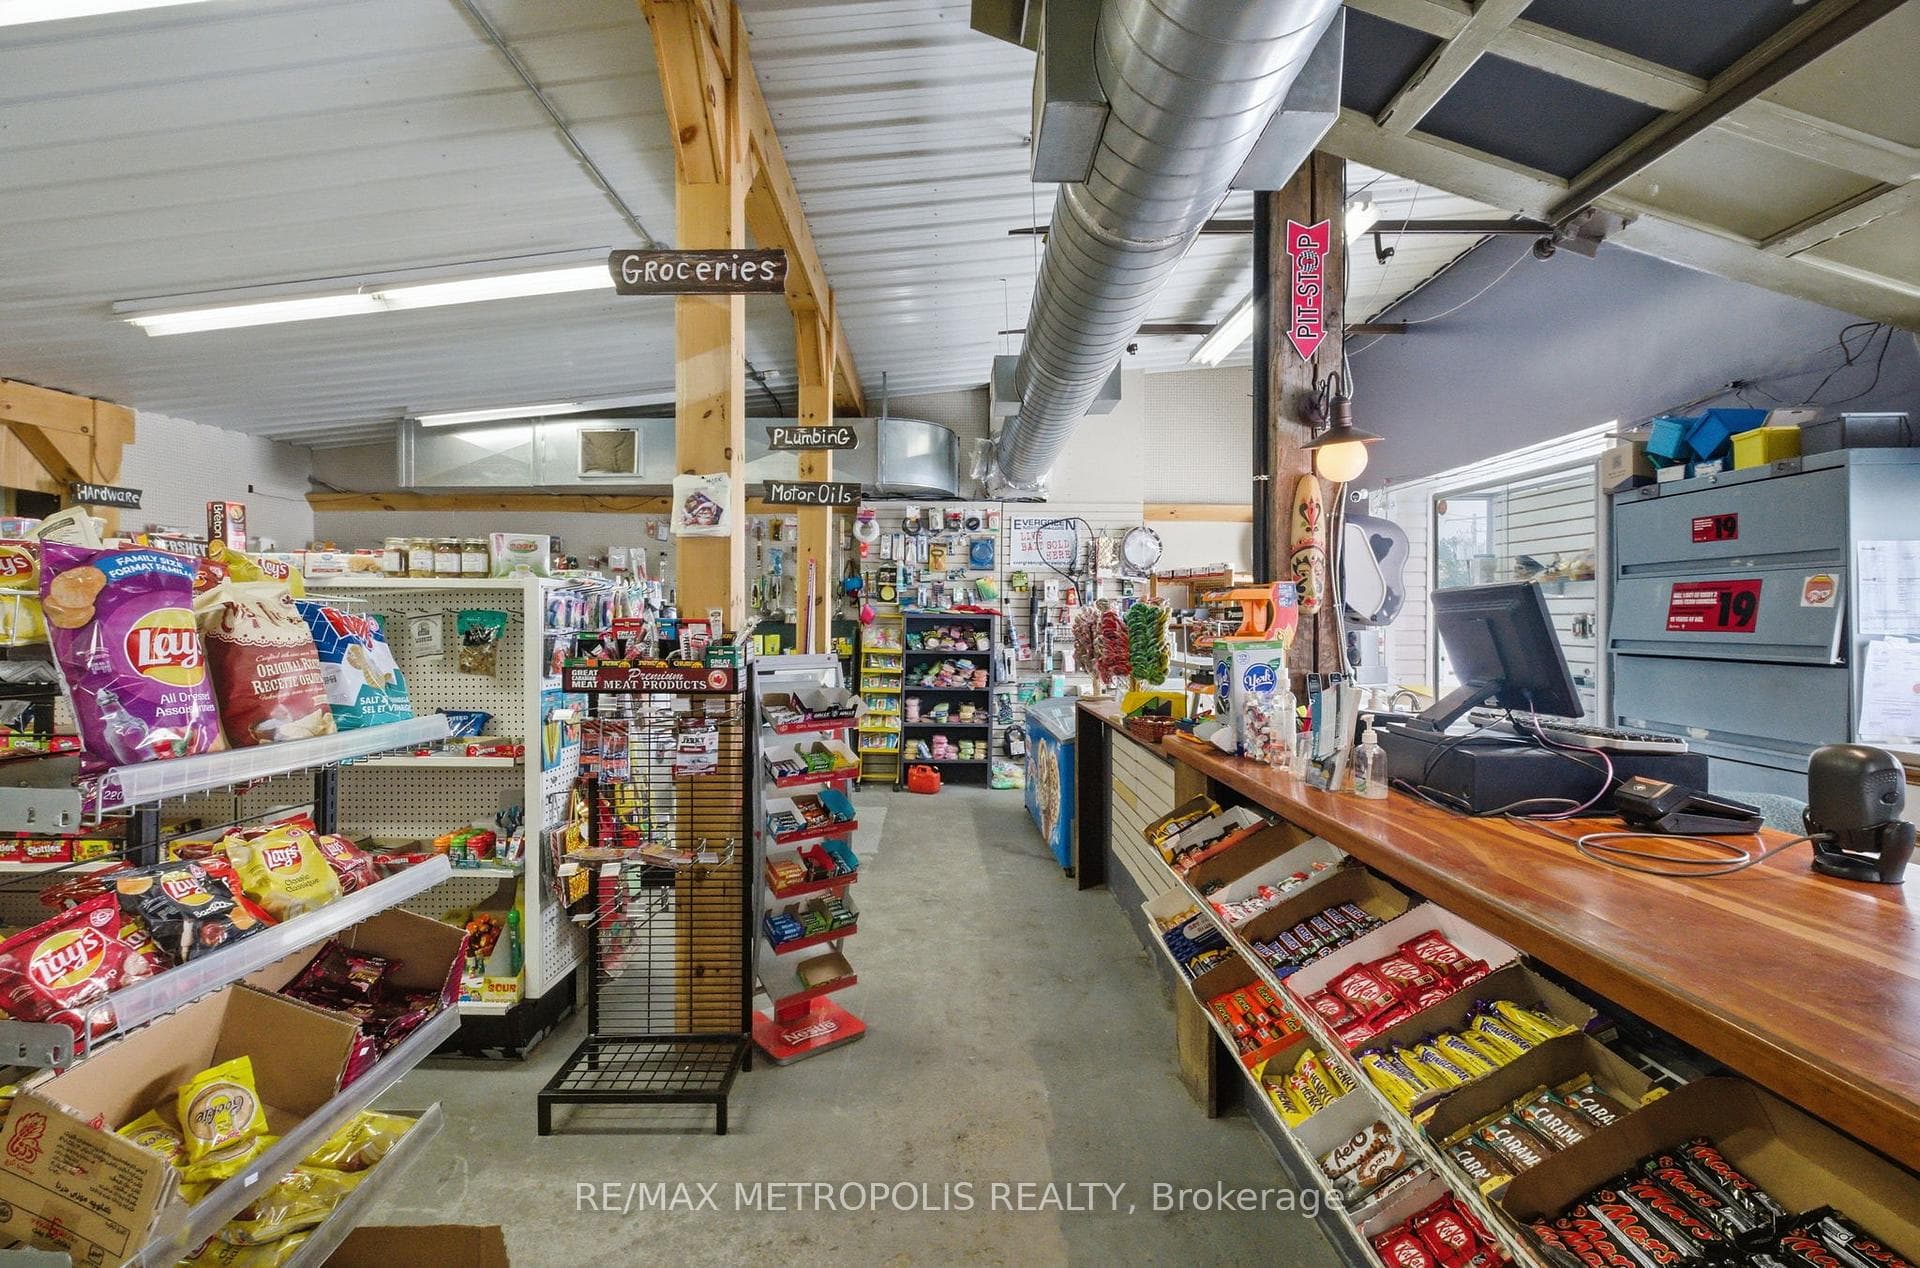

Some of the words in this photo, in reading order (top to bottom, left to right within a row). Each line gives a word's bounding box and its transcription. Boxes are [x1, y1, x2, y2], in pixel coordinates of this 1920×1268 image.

[1297, 235, 1319, 340] PIT-STOP
[770, 483, 815, 503] Motor
[818, 484, 851, 504] Oils
[1014, 519, 1076, 530] EVERGREEN
[1715, 517, 1736, 539] 19
[1047, 540, 1069, 550] SOLD
[115, 554, 157, 567] FAMILY
[160, 557, 184, 569] SIZE
[1047, 550, 1072, 560] HERE
[109, 562, 154, 579] FORMAT
[1718, 590, 1756, 627] 19
[256, 659, 301, 678] ORIGINAL
[628, 668, 684, 681] Premium
[571, 680, 598, 688] MEAT
[603, 680, 638, 689] MEAT
[642, 680, 707, 689] PRODUCTS
[160, 694, 176, 705] All
[360, 696, 380, 706] SALT
[362, 706, 376, 715] SEL
[377, 705, 386, 714] ET
[264, 845, 300, 872] Lay's
[33, 933, 101, 984] Lay's
[1334, 1131, 1367, 1168] Aero
[1687, 1146, 1757, 1191] Mars
[1653, 1168, 1721, 1208] Mars
[1435, 1217, 1468, 1247] KitKat
[1600, 1204, 1680, 1264] Mars
